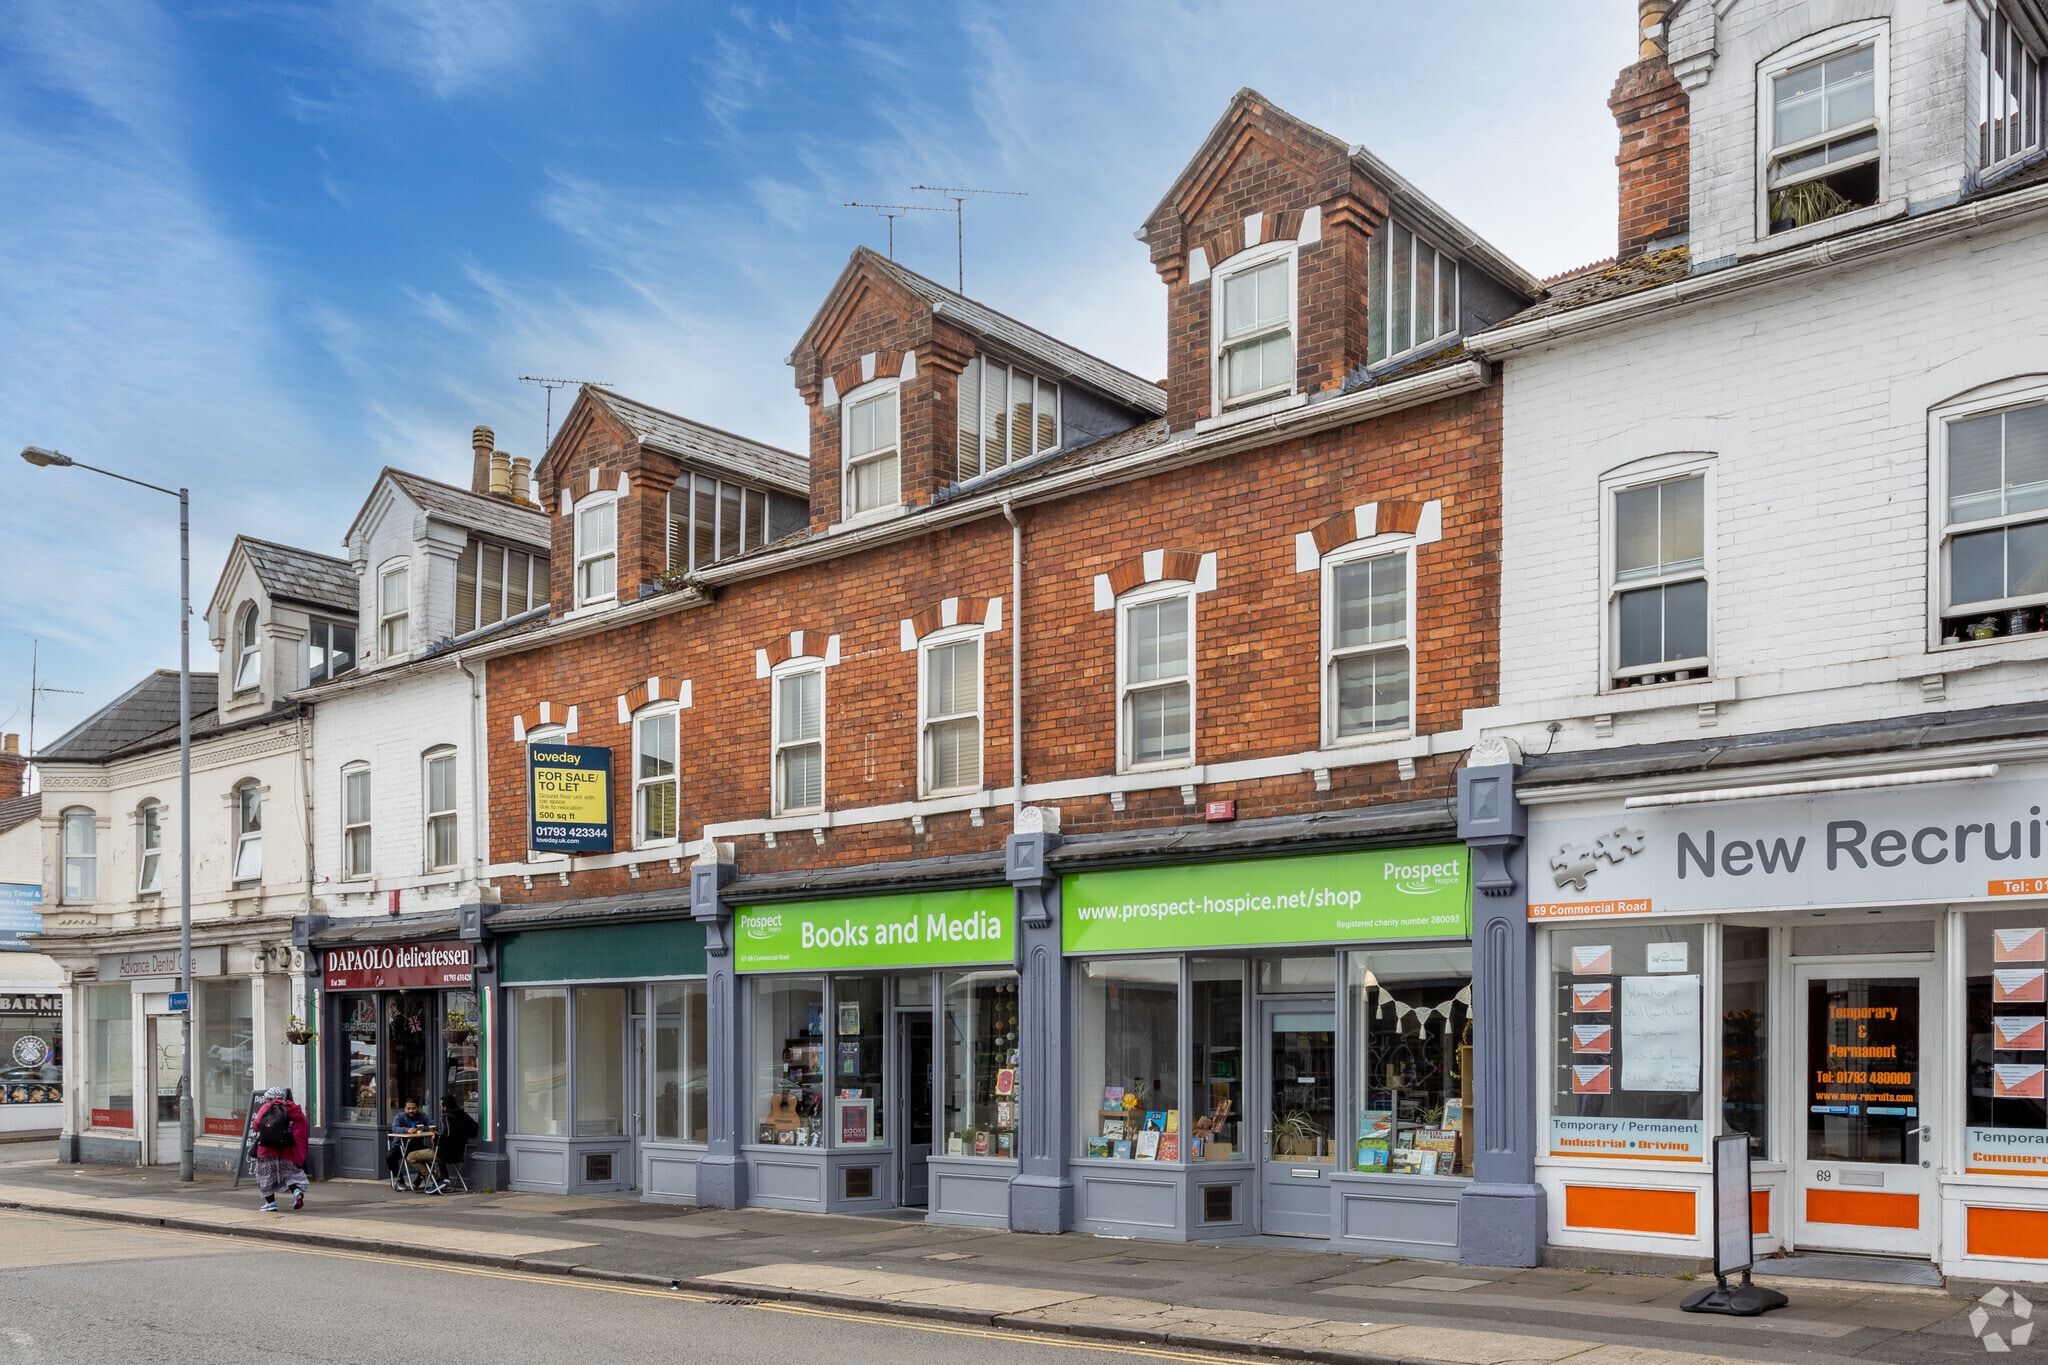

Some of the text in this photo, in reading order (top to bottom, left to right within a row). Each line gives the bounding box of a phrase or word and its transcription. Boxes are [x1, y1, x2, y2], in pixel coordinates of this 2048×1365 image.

[534, 750, 580, 766] loveday
[538, 772, 598, 783] FOR SALE/
[539, 782, 579, 792] TO LET
[536, 826, 607, 837] 01793 423344
[1677, 805, 2048, 880] New Recrui
[1384, 859, 1460, 881] Prospect
[1434, 876, 1458, 885] Hospice
[2004, 880, 2029, 892] Tel:
[1077, 888, 1362, 922] www.prospect-hospice.net/shop
[1534, 901, 1646, 915] 69 Commercial Road
[741, 913, 782, 930] Prospect
[1336, 915, 1460, 930] Registered charity number 280093
[802, 910, 1001, 948] Books and Media
[120, 958, 149, 974] Advance
[152, 952, 176, 972] Dental
[329, 947, 469, 971] DAPAOLO delicatessen
[1626, 982, 1679, 998] Warehouse
[1829, 1005, 1897, 1021] Temporary
[1858, 1025, 1867, 1038] &
[1828, 1044, 1896, 1058] Permanent
[1817, 1070, 1911, 1085] Tel: 01793 480000
[1816, 1092, 1913, 1102] www.new-recruits.com
[1553, 1119, 1698, 1133] Temporary / Permanent
[1560, 1138, 1689, 1152] Industrial Driving
[1817, 1170, 1831, 1181] 69
